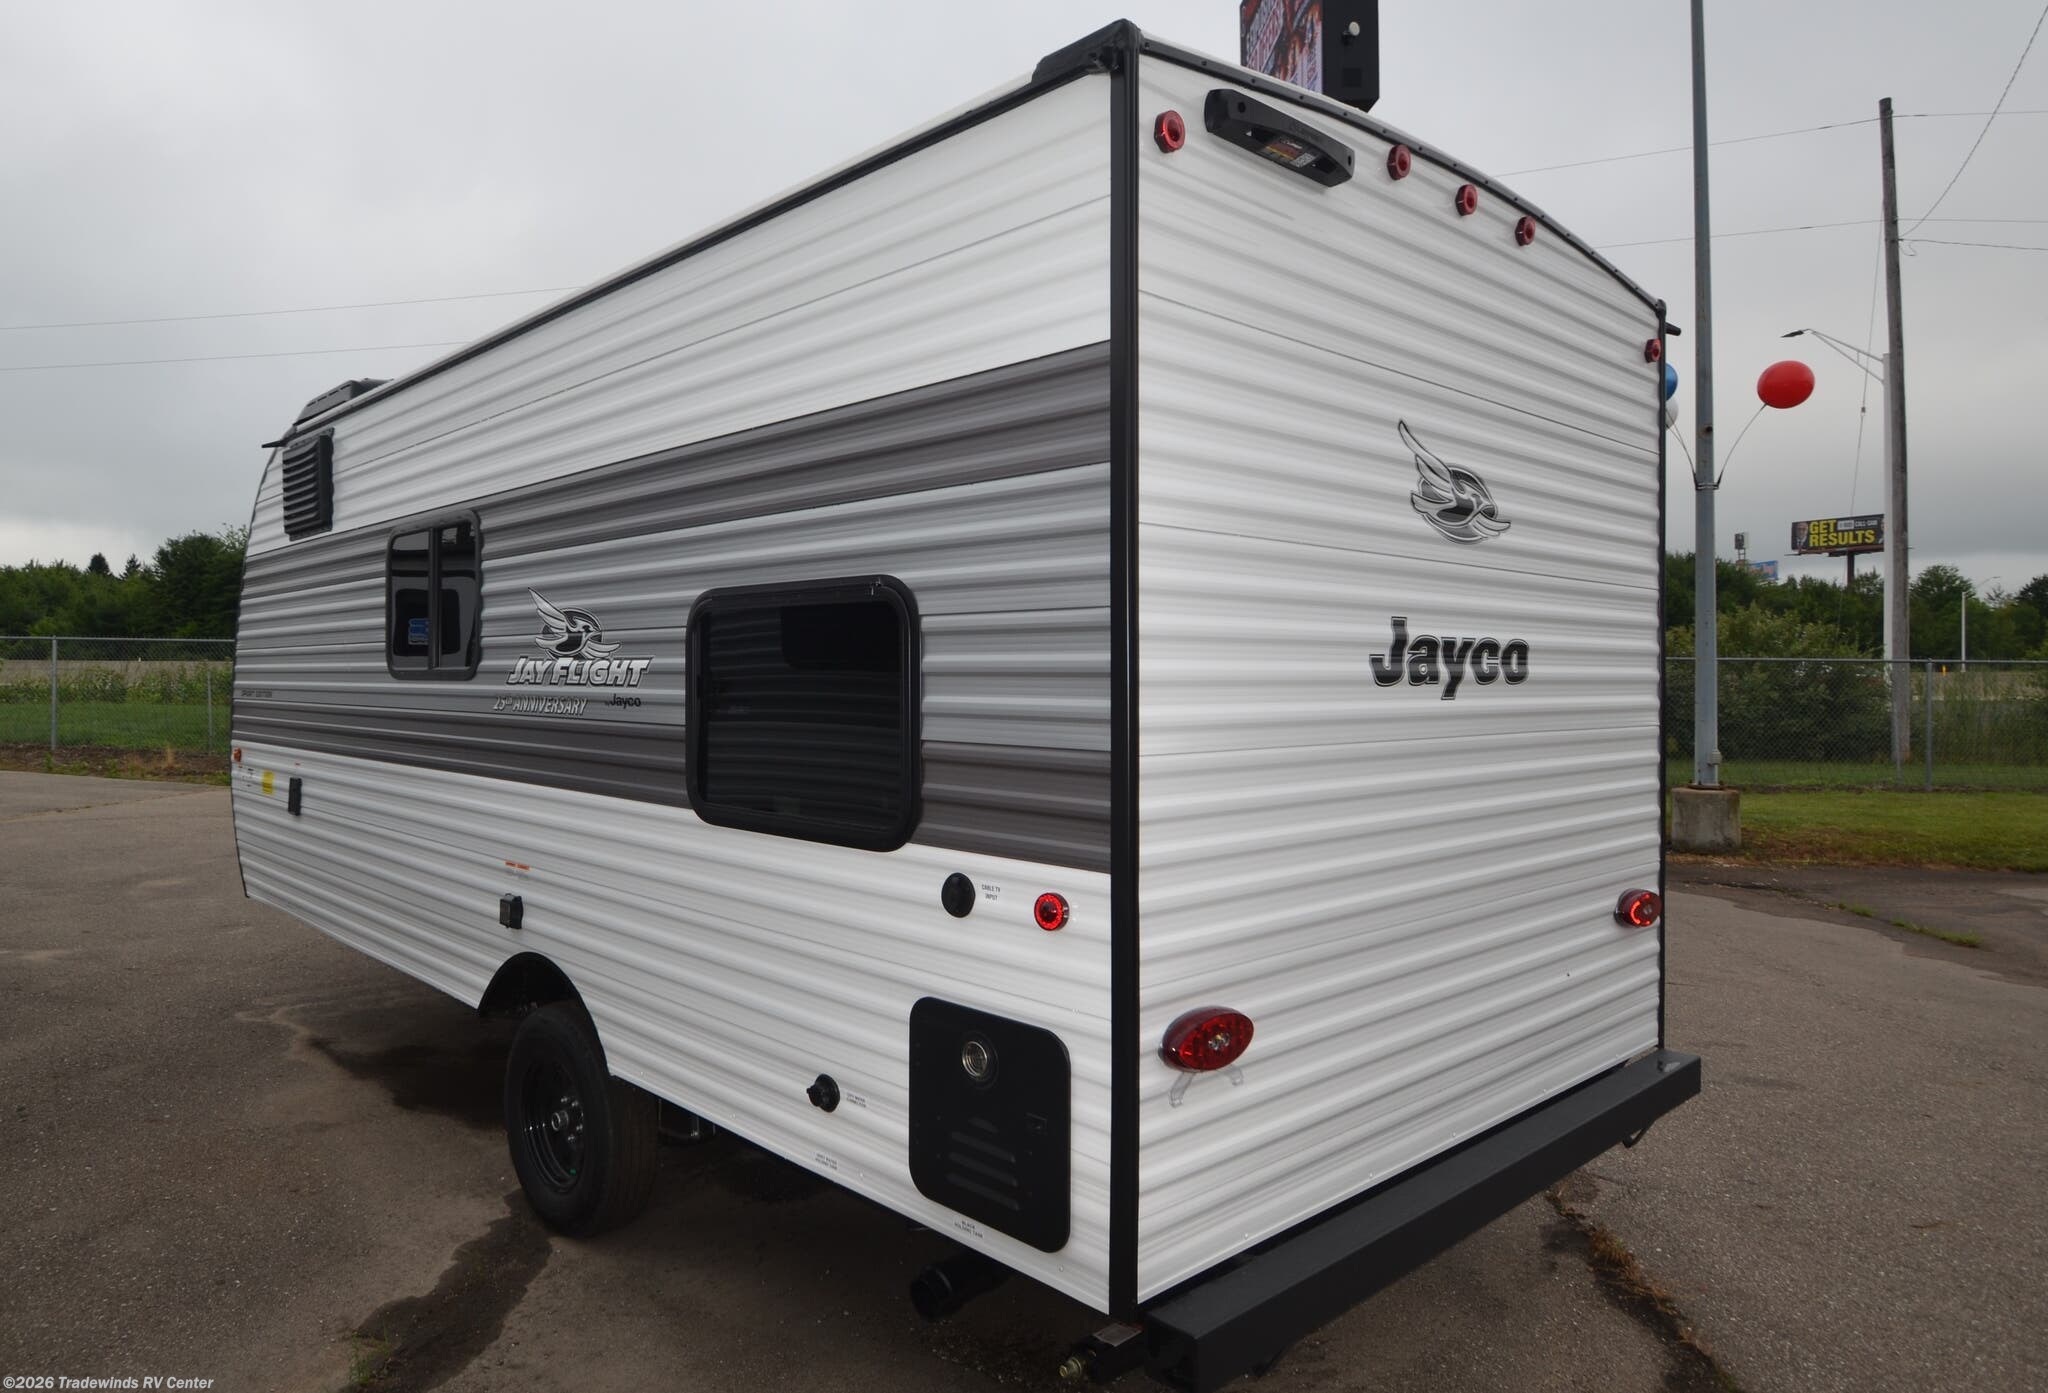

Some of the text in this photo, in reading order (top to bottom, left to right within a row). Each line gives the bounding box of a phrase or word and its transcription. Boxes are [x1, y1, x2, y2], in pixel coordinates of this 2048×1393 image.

[1809, 519, 1837, 534] GET
[1809, 529, 1876, 547] RESULTS
[1369, 616, 1530, 700] Jayco
[506, 656, 655, 688] JAY FLIGHT
[512, 695, 589, 716] ANNIVERSARY
[609, 693, 642, 709] Jayco
